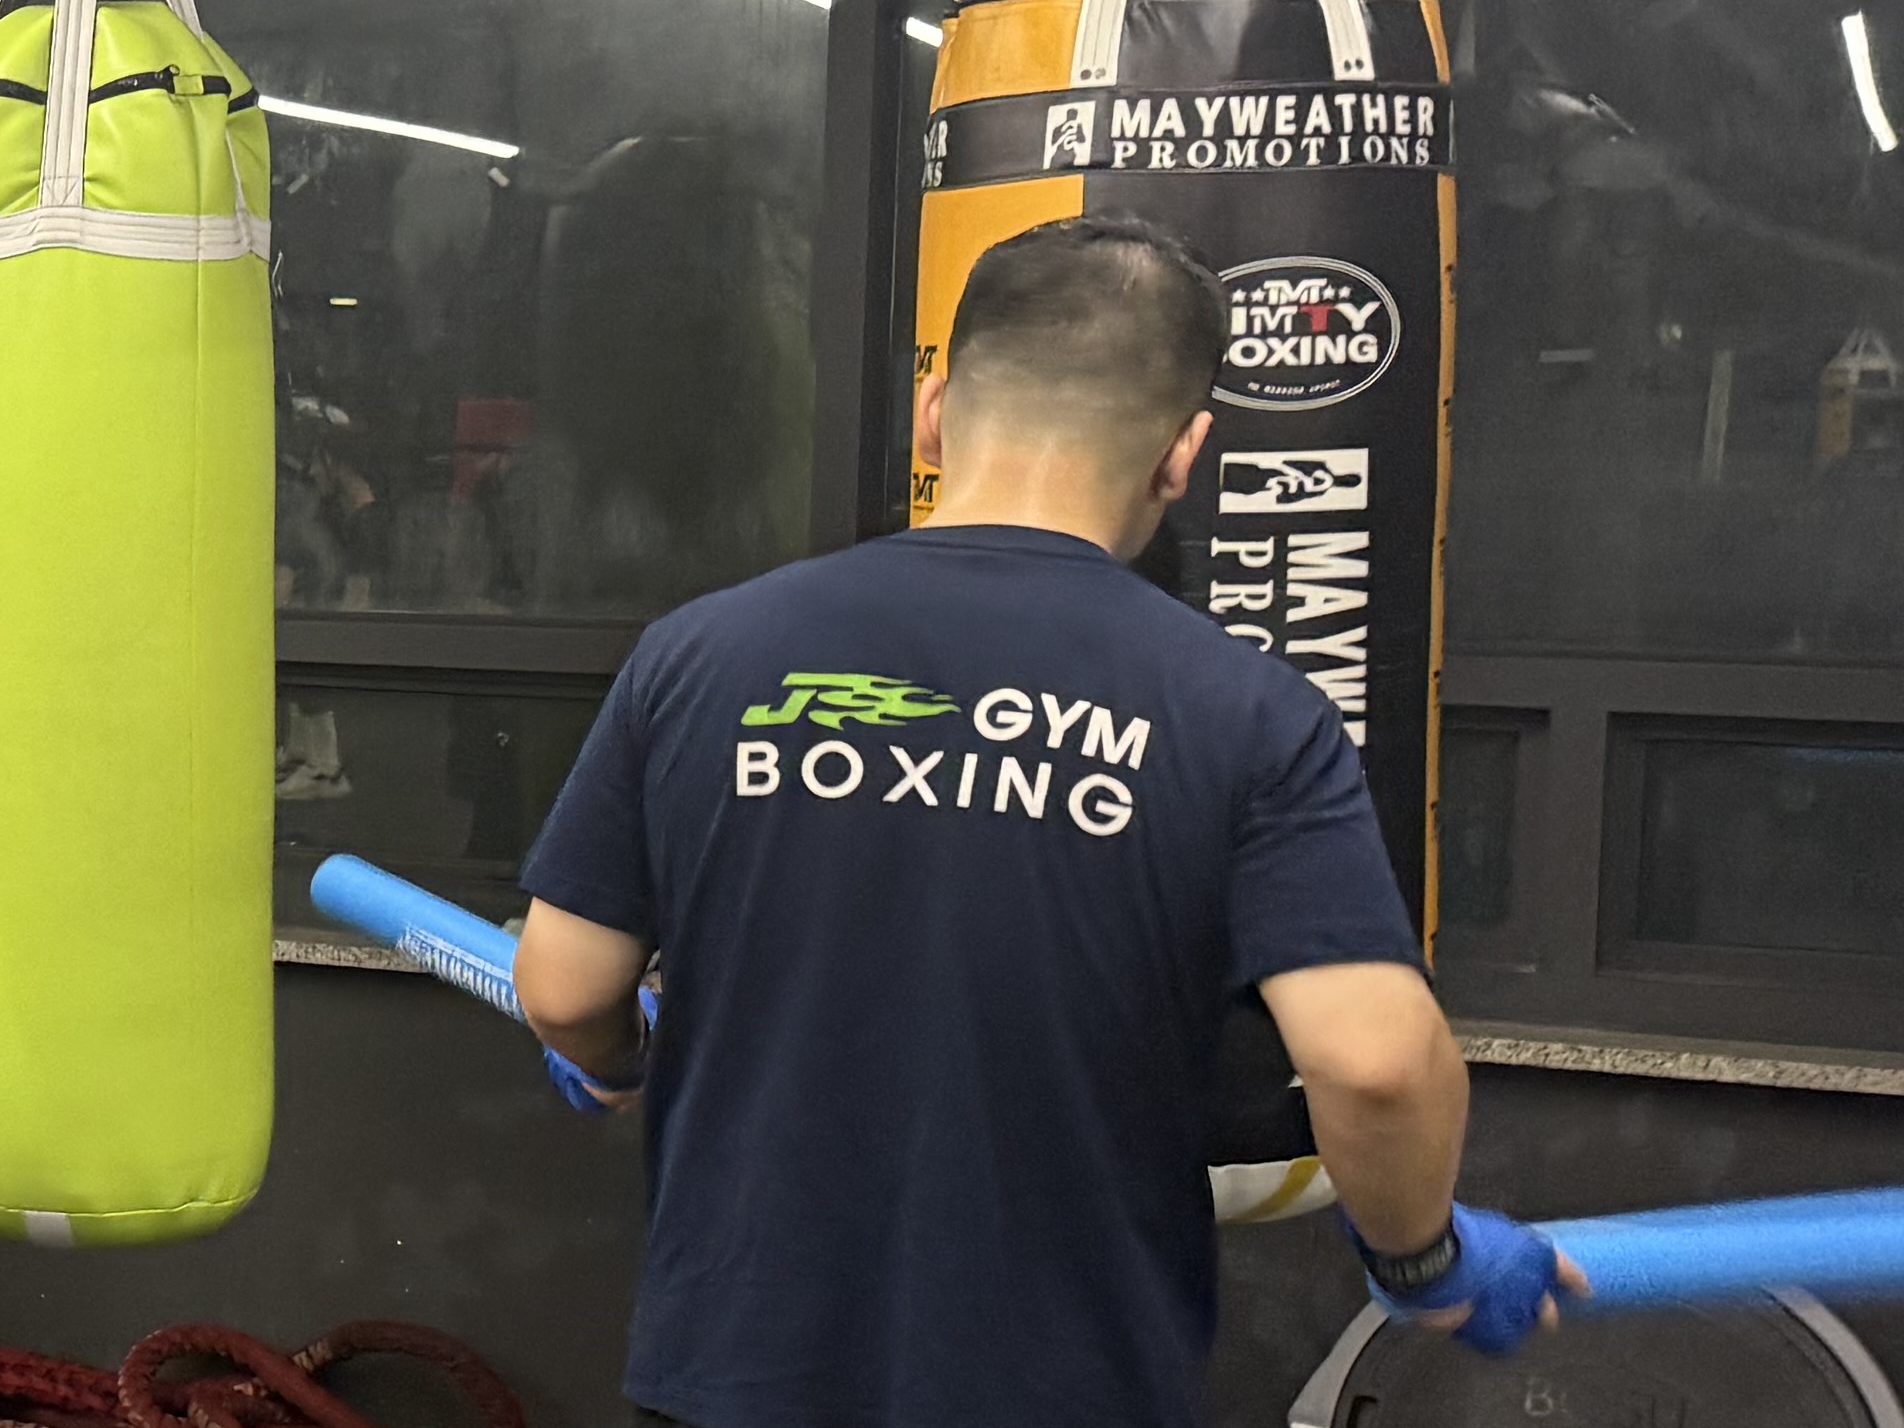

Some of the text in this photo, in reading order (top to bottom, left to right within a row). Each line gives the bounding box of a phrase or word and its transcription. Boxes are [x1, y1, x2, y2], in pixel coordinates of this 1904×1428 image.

[1110, 93, 1435, 139] MAYWEATHER
[1111, 136, 1431, 169] PROMOTIONS
[1222, 333, 1379, 368] OXING
[973, 687, 1151, 770] GYM
[736, 739, 1135, 836] BOXING
